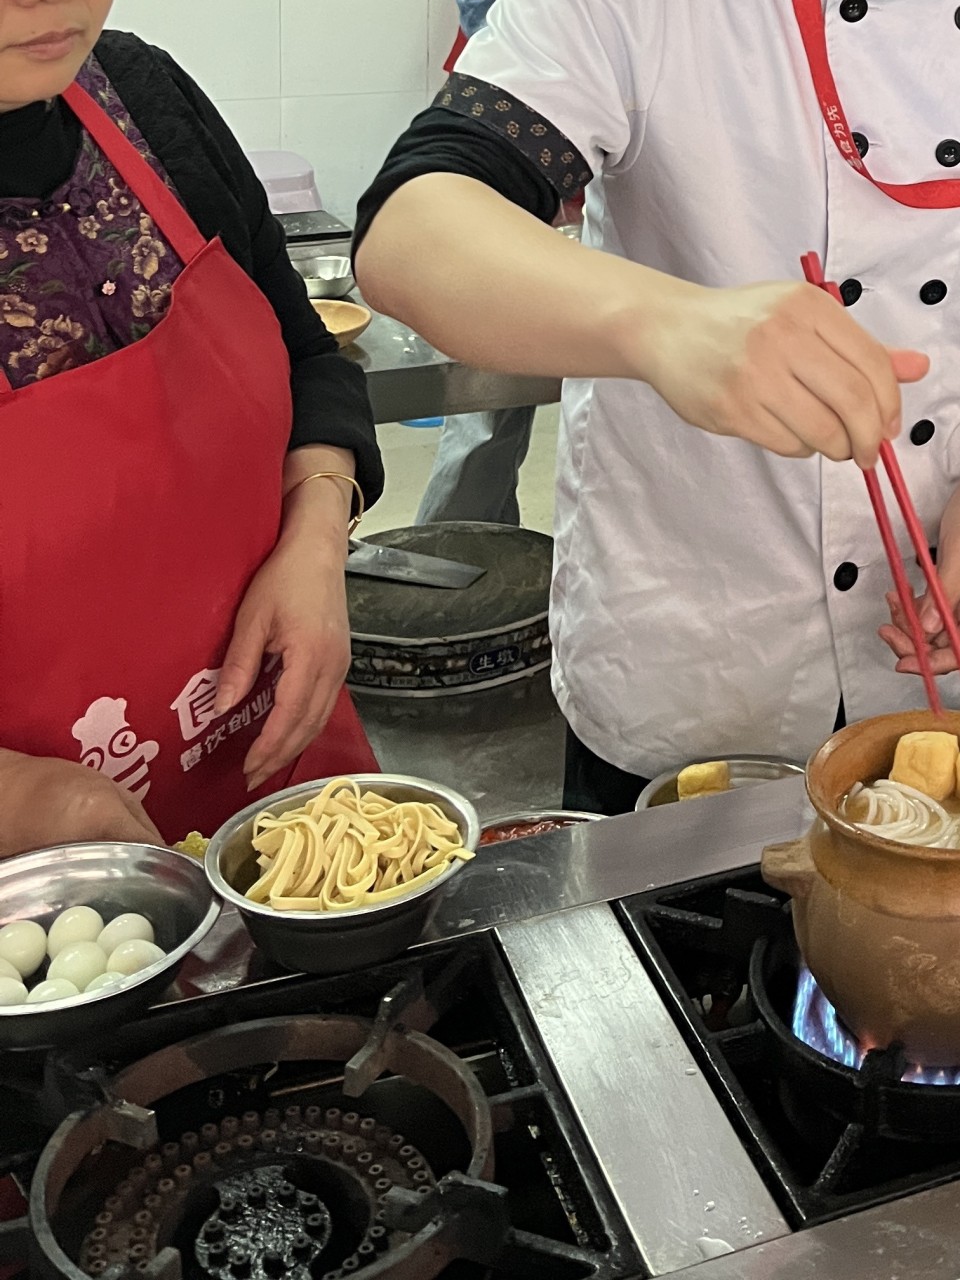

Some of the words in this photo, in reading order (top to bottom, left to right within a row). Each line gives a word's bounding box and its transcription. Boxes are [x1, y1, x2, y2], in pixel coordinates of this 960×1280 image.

[826, 105, 853, 154] 食为先
[180, 668, 281, 772] 餐饮创业
